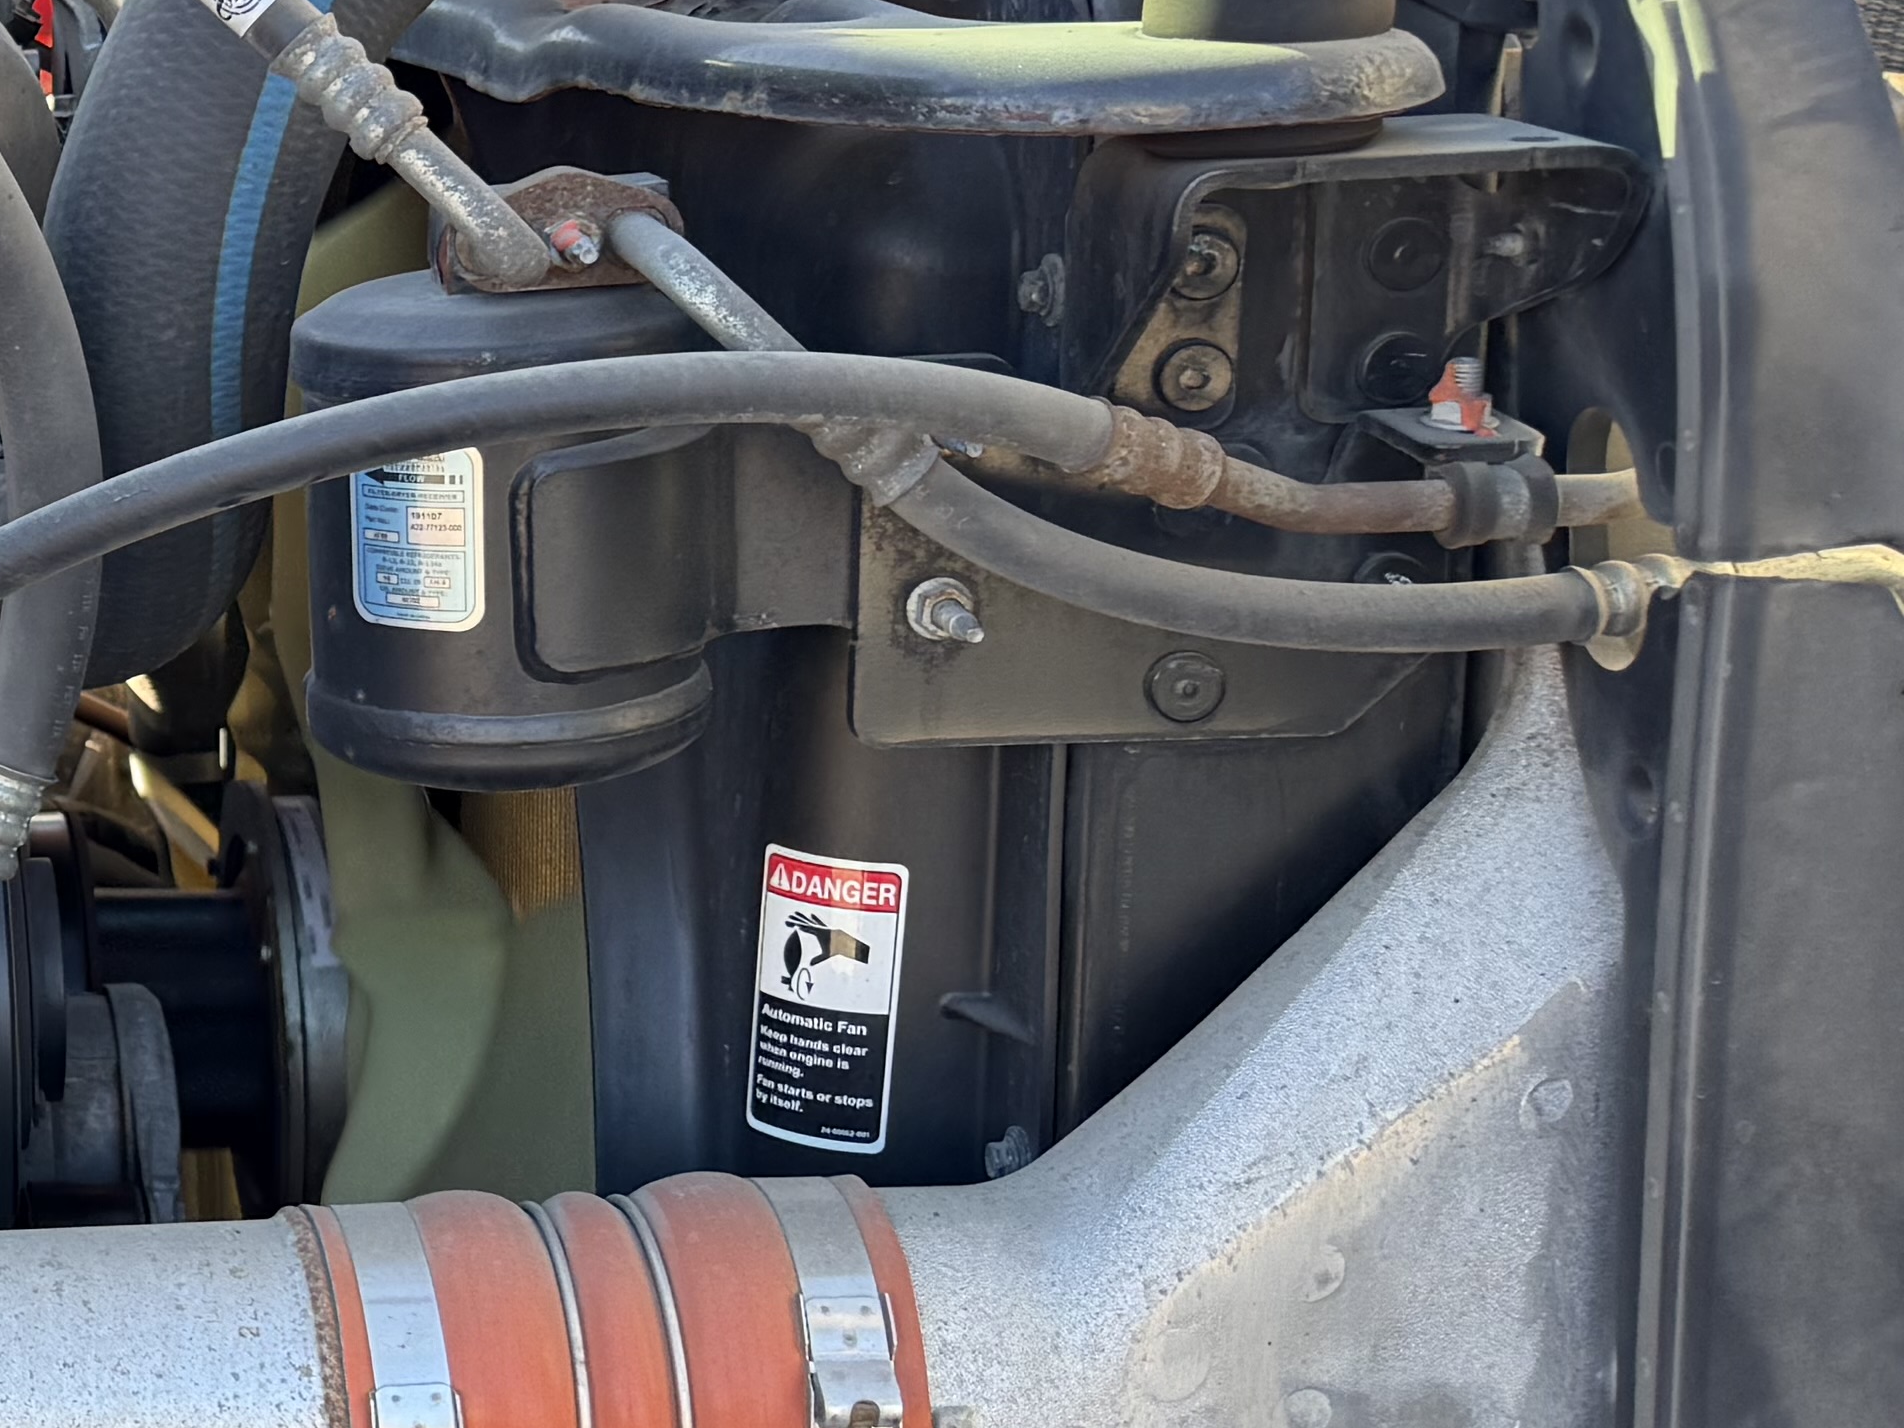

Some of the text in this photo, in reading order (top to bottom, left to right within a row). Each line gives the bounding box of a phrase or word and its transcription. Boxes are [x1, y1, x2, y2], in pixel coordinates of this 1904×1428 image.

[398, 475, 425, 483] FLOW
[790, 870, 897, 907] DANGER
[761, 1002, 868, 1036] Automatic Fan
[760, 1024, 869, 1057] Keep hands clear
[760, 1040, 850, 1070] when engine is
[758, 1055, 804, 1078] running.
[755, 1087, 804, 1113] by itself.
[756, 1073, 874, 1109] Fan starts or stops
